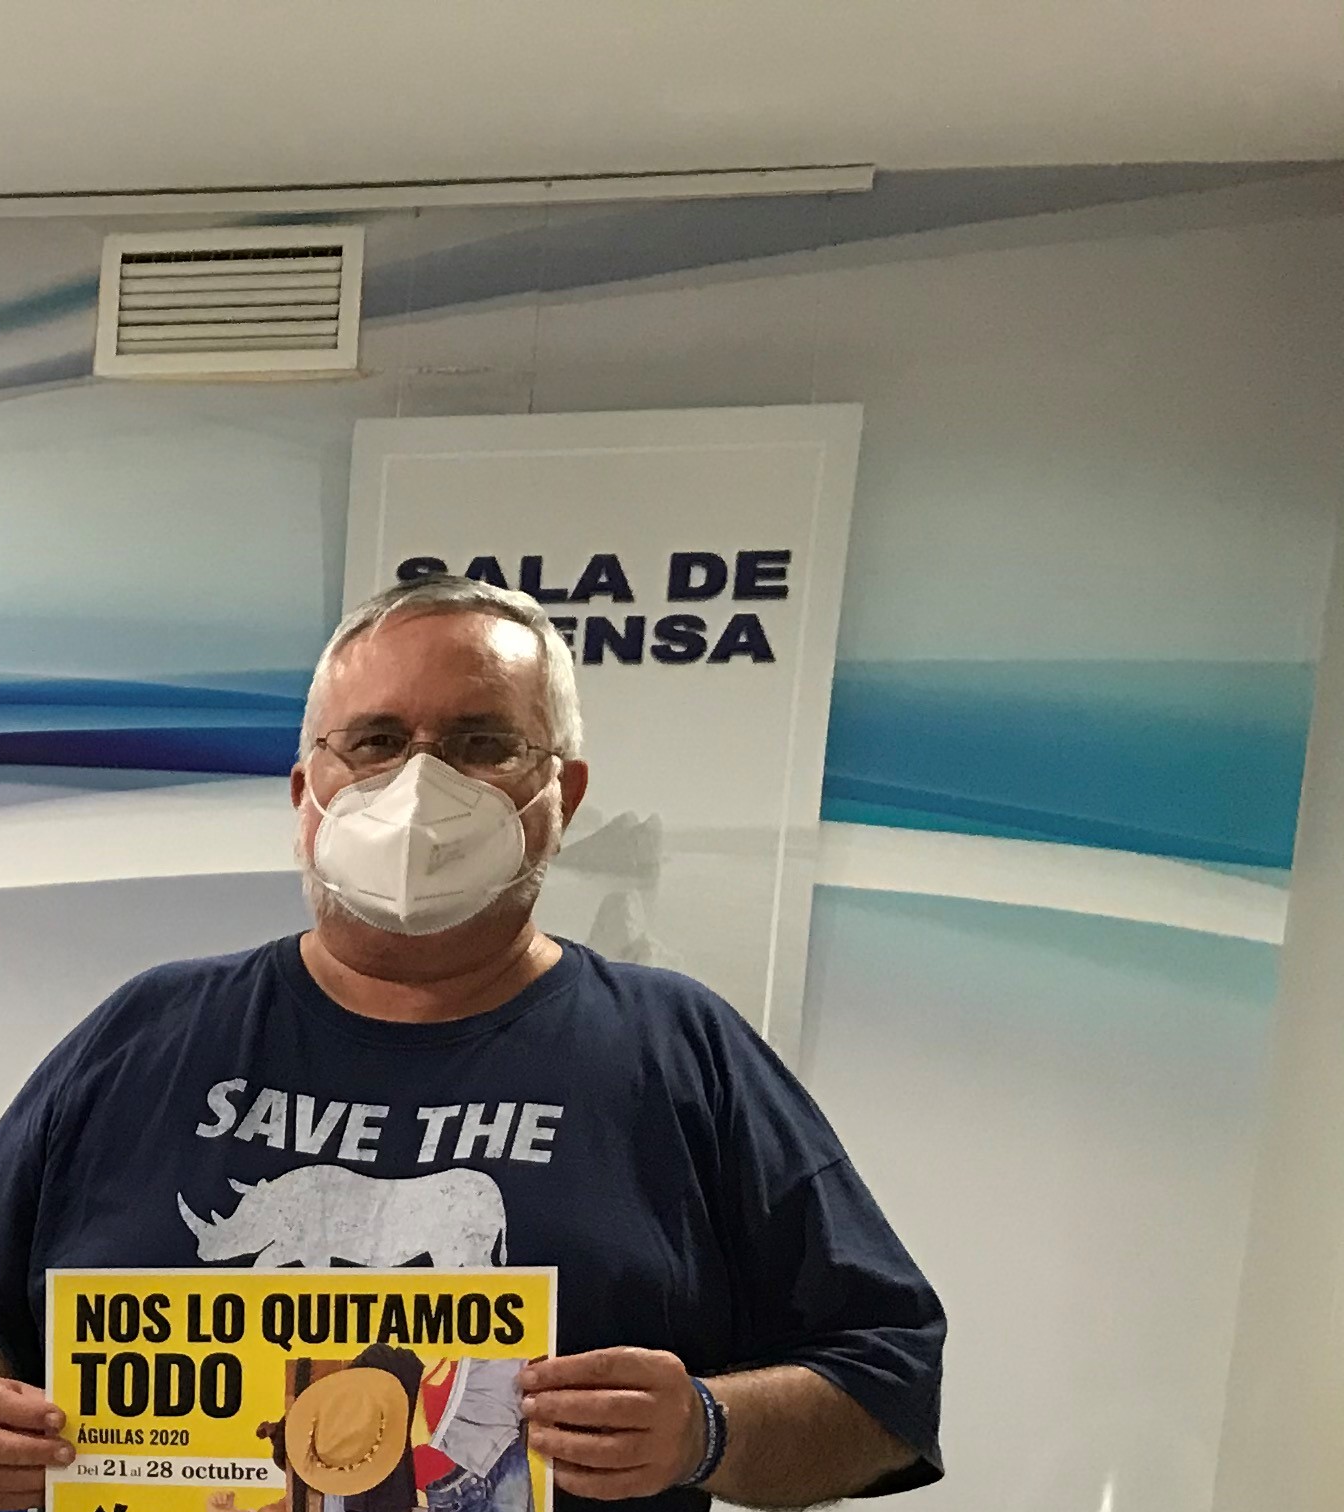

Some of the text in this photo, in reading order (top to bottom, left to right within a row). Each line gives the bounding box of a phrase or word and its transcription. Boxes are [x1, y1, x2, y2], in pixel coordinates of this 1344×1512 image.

[397, 550, 791, 603] SALA DE
[196, 1078, 564, 1164] SAVE THE
[76, 1293, 524, 1351] NOS LO QUITAMOS
[71, 1352, 242, 1419] TODO
[77, 1423, 189, 1446] ÁGUILAS 2020
[77, 1459, 267, 1481] Del 21 al 28 octubre
